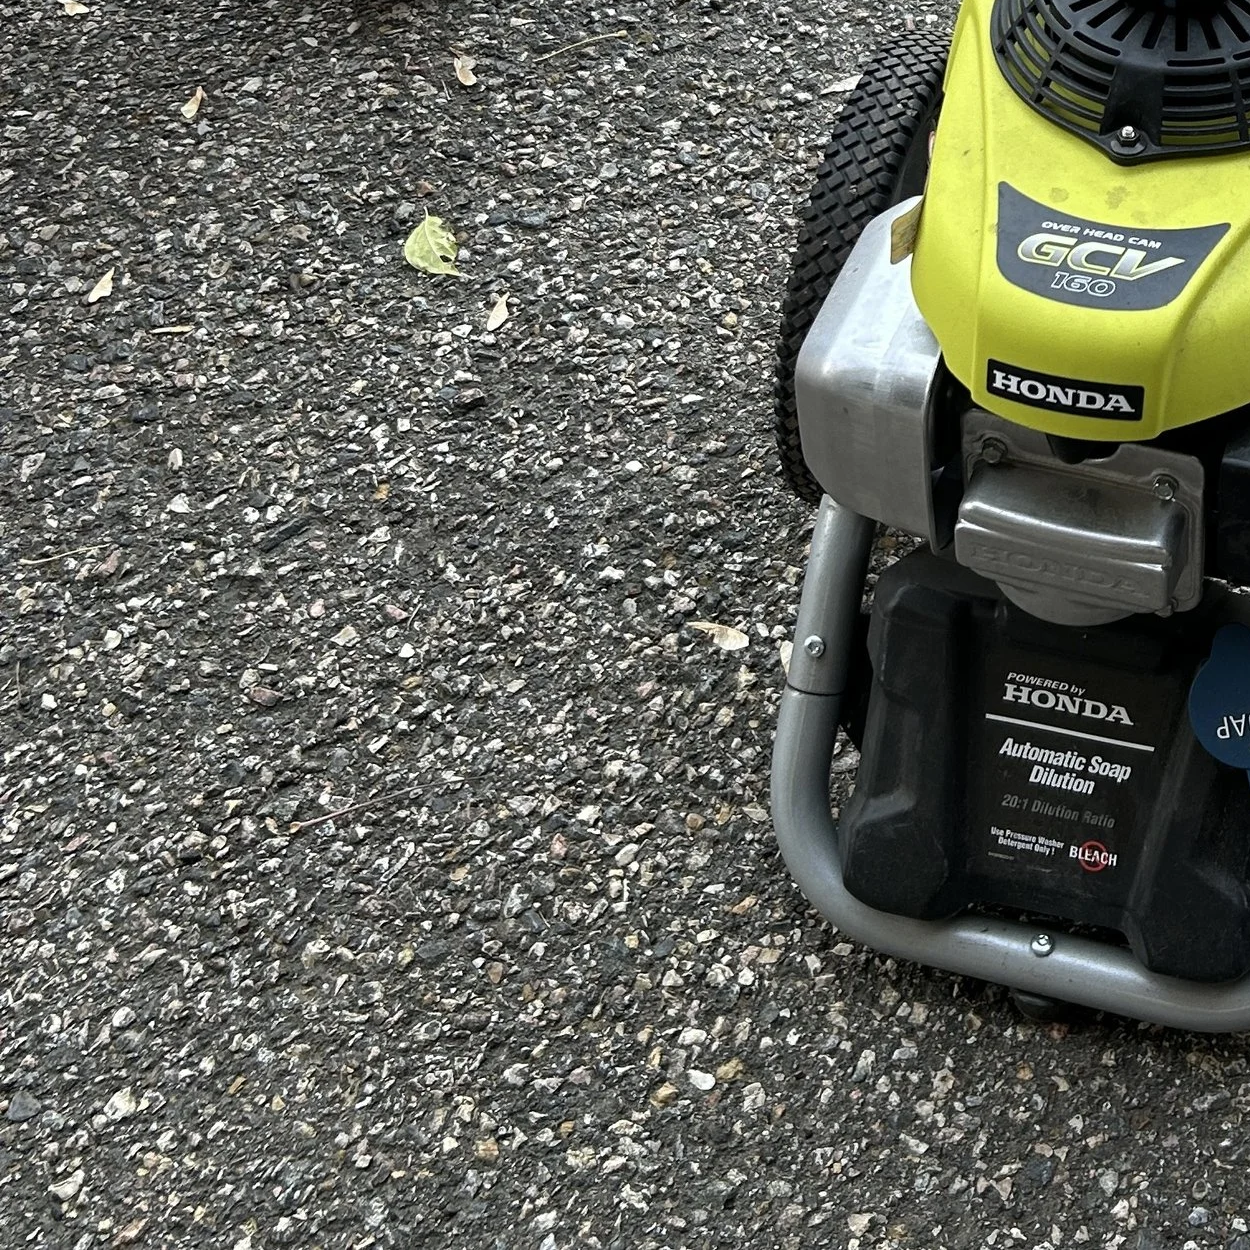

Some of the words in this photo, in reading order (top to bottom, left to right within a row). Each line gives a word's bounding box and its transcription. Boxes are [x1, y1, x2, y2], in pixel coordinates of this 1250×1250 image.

[1041, 221, 1081, 234] OVER
[1083, 228, 1125, 242] HEAD
[1128, 237, 1162, 250] CAM
[1017, 232, 1186, 281] GCV
[1050, 271, 1116, 297] 160
[992, 369, 1136, 414] HONDA
[1007, 672, 1069, 691] POWERED
[1070, 684, 1086, 696] by
[1002, 683, 1134, 726] HONDA
[999, 737, 1087, 771] Automatic
[1088, 755, 1132, 783] Soap
[1029, 764, 1096, 795] Dilution
[1001, 793, 1029, 810] 20:1
[1031, 799, 1080, 822] Dilution
[1081, 810, 1116, 829] Ratio
[990, 826, 1005, 837] Use
[1005, 829, 1037, 843] Pressure
[1038, 836, 1064, 849] Washer
[998, 836, 1034, 851] Detergent
[1034, 842, 1051, 856] Only
[1069, 845, 1118, 867] BLEACH
